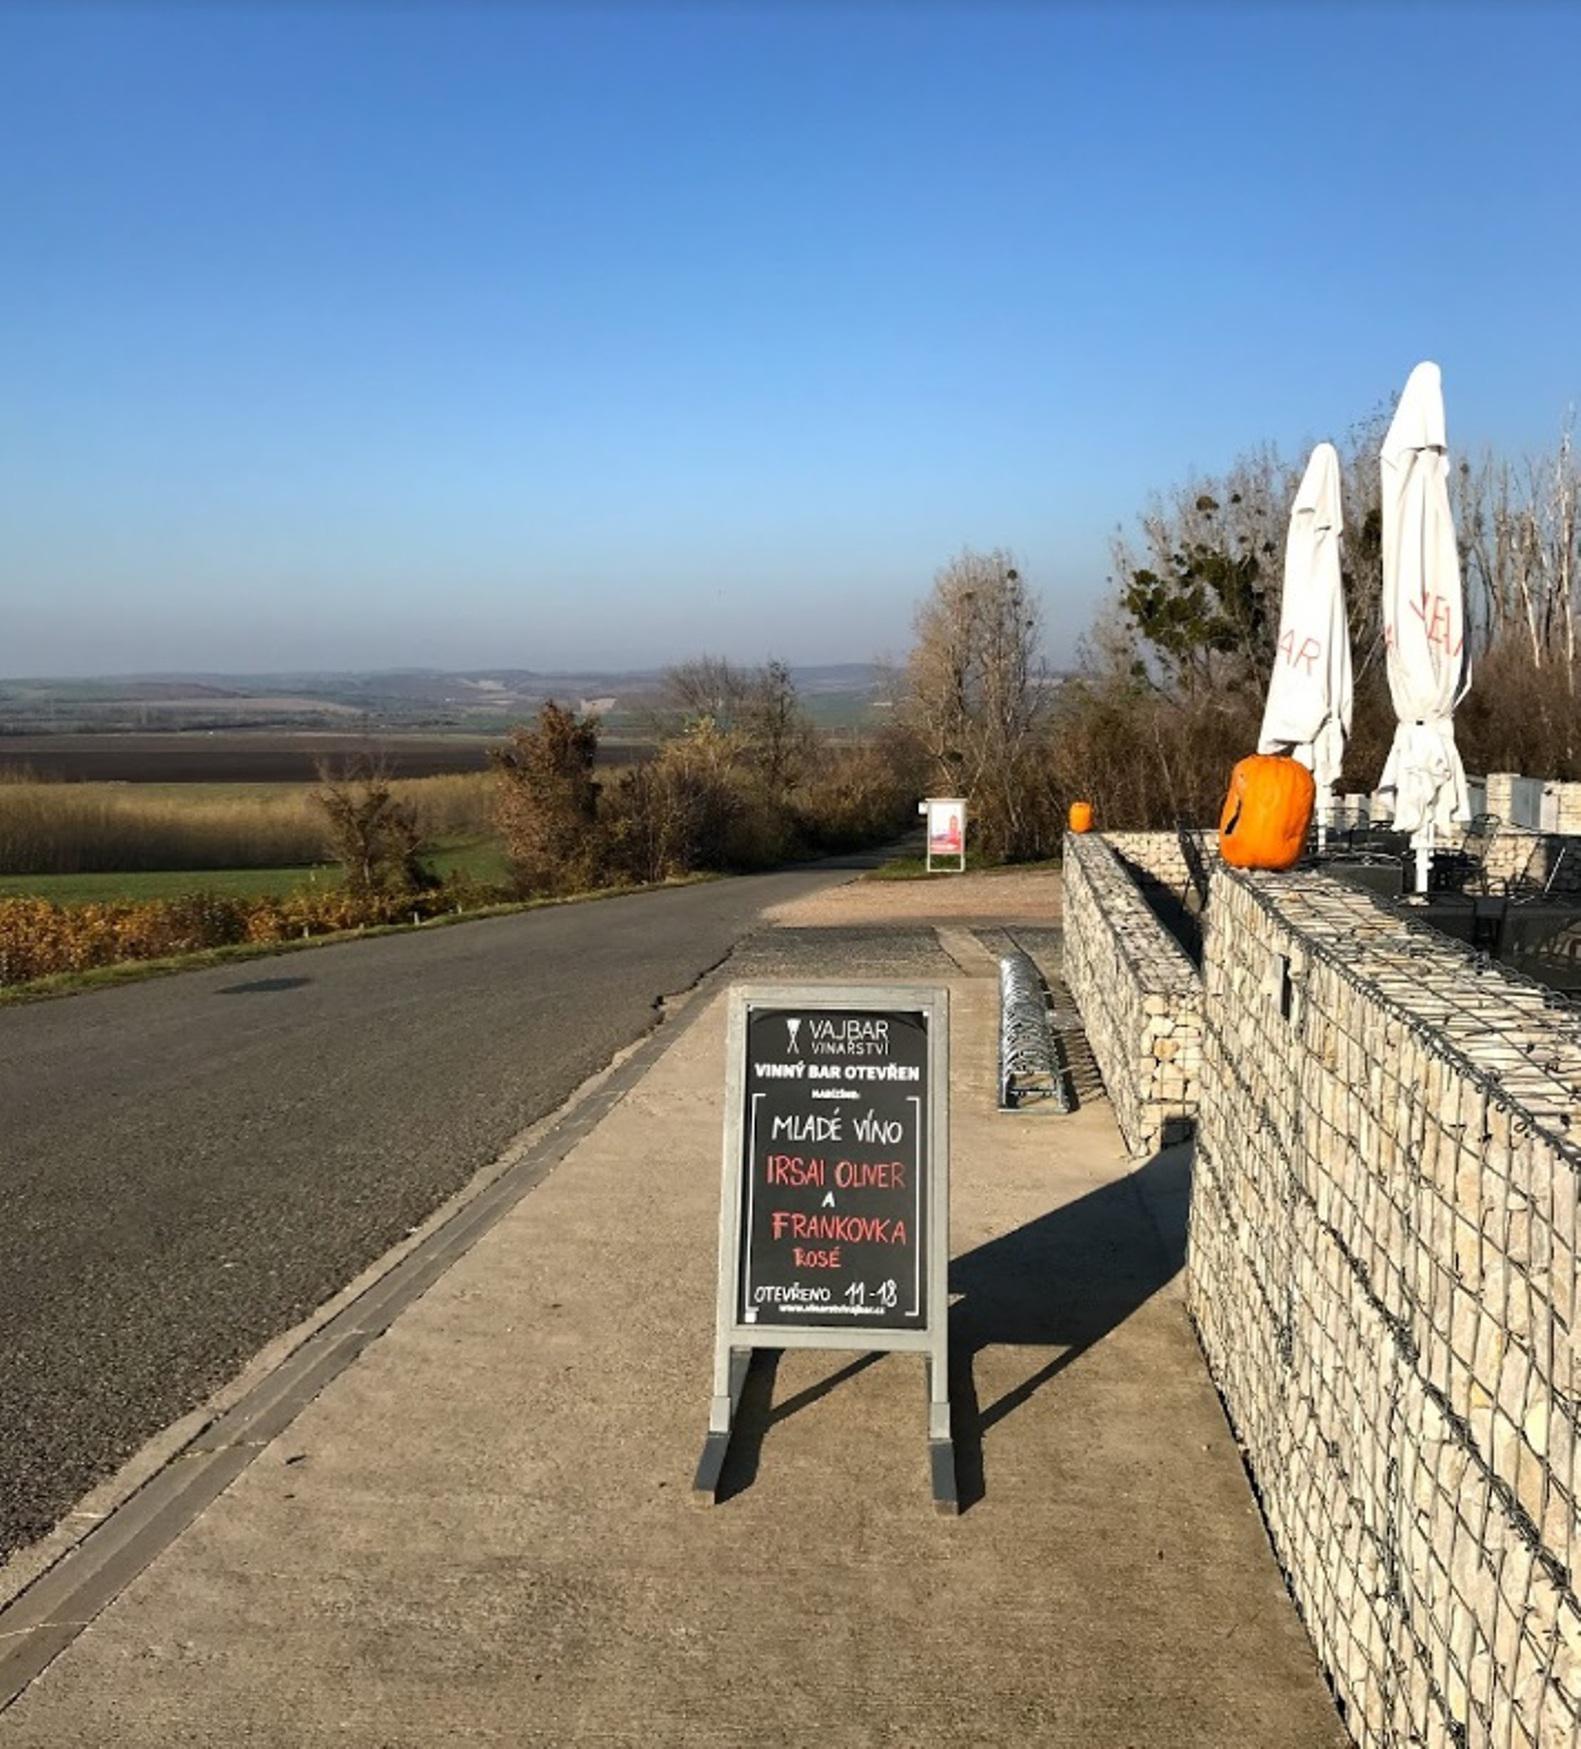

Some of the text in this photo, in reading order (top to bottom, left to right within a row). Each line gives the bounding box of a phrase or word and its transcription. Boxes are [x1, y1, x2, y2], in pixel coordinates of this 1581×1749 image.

[809, 1020, 889, 1040] VAJBAR
[754, 1060, 920, 1081] VINNÝ BAR OTEVŘEN
[771, 1107, 903, 1145] MLADÉ VÍNO
[766, 1155, 906, 1189] IRSAI OLIVER
[821, 1190, 836, 1208] A
[771, 1211, 907, 1246] FRANKOVKA
[792, 1246, 842, 1269] ROSÉ
[754, 1281, 831, 1303] OTEVŘENO
